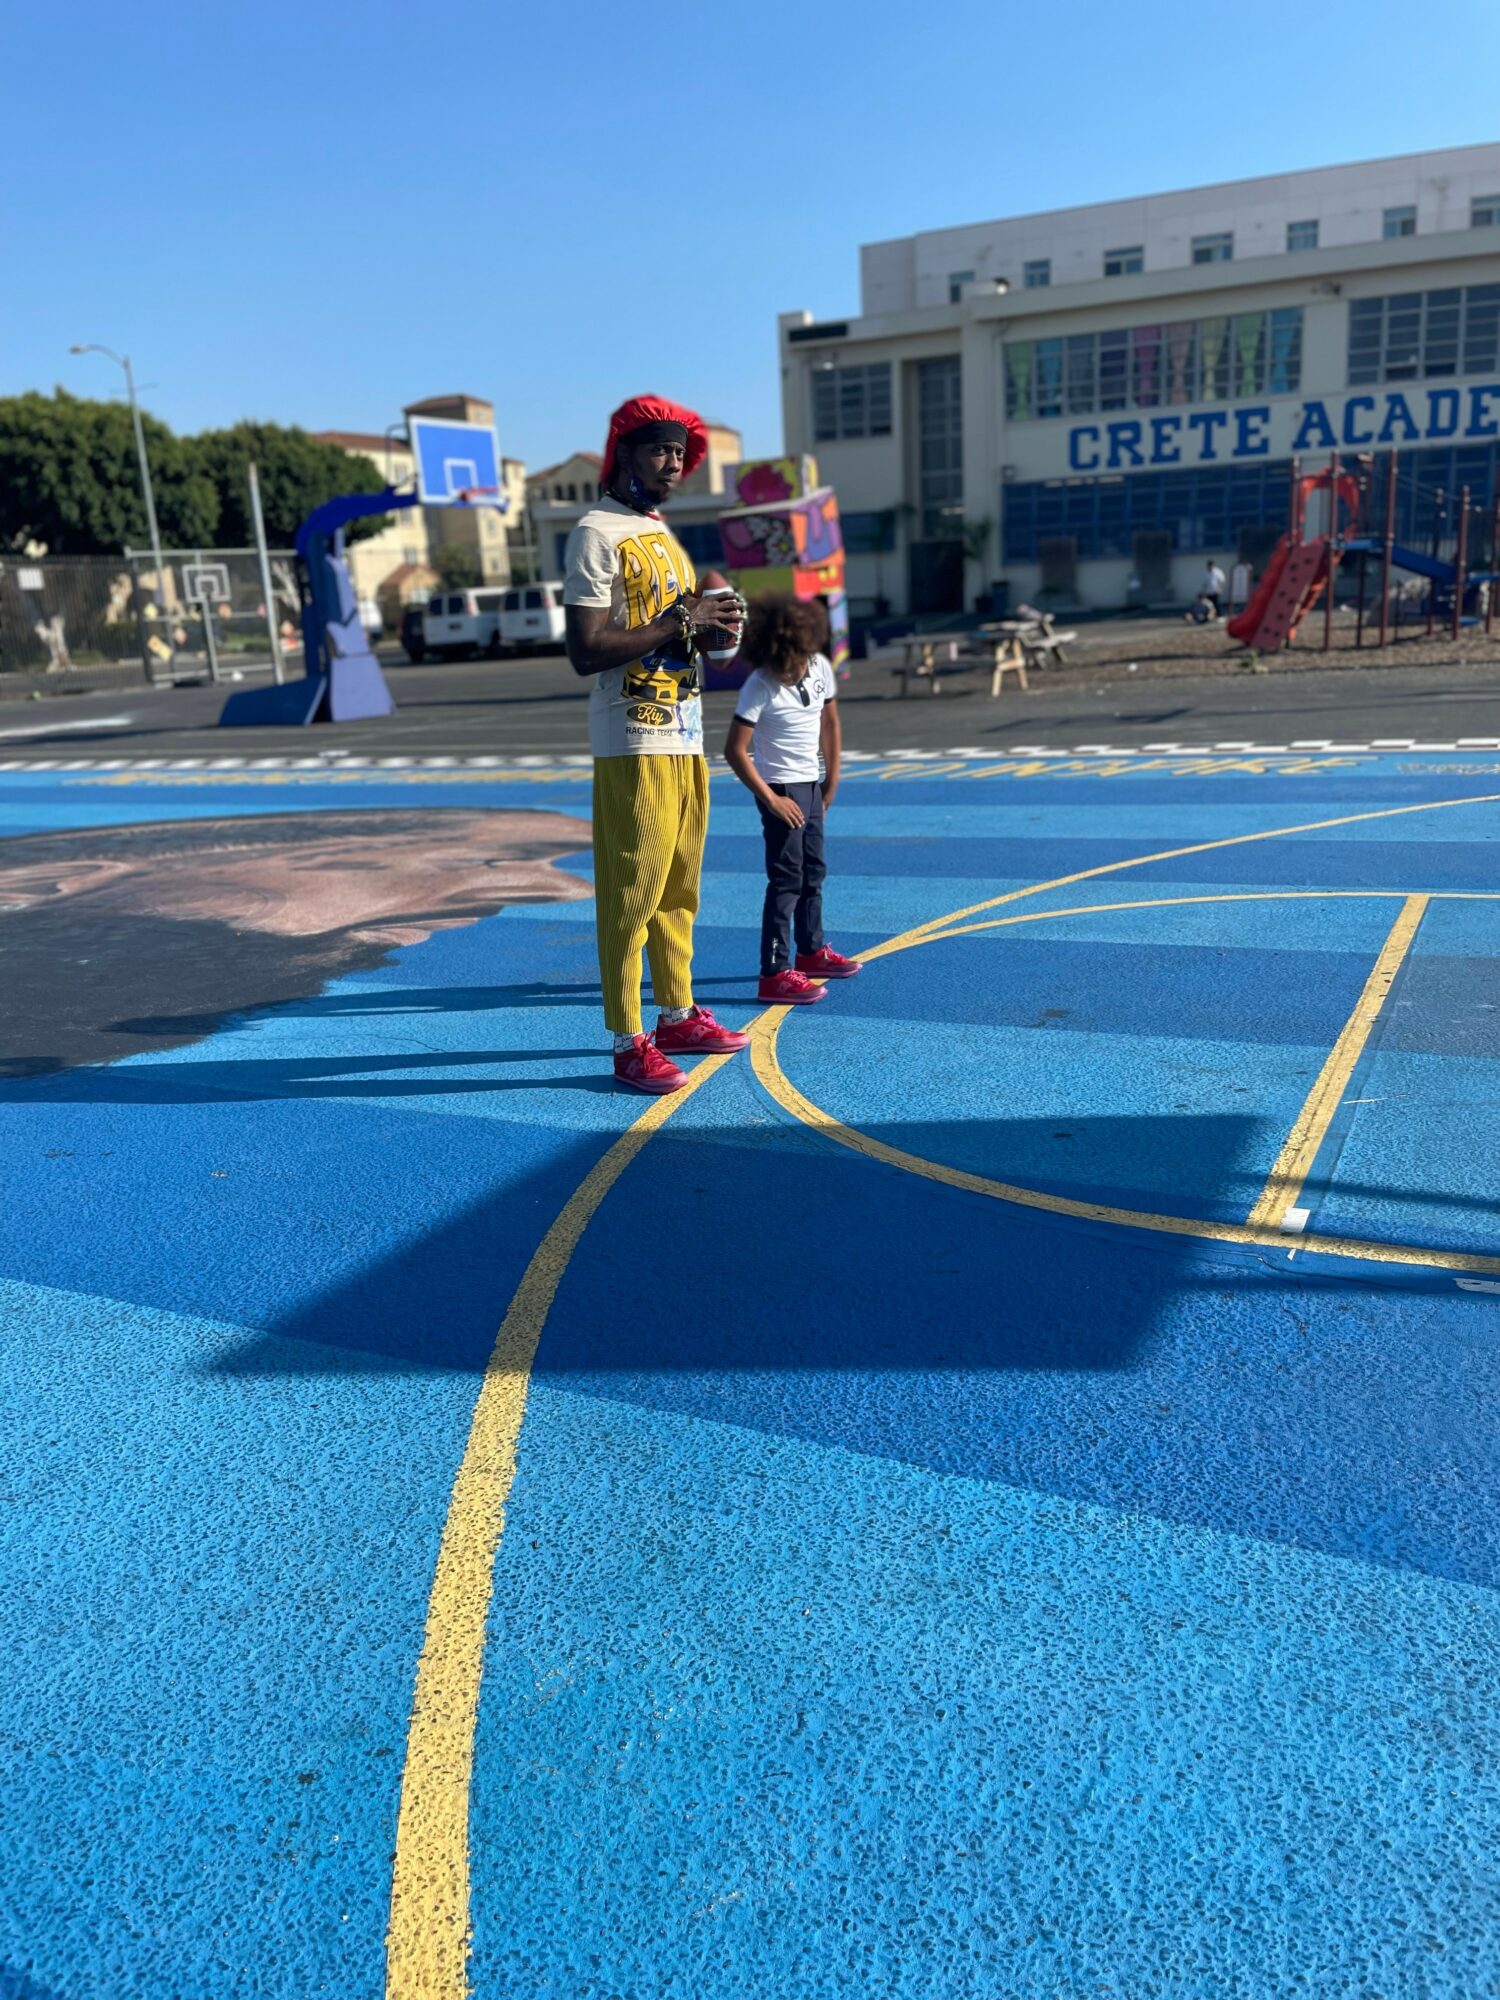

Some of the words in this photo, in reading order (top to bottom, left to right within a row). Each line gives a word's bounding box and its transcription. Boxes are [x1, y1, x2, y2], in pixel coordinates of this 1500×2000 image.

[1069, 406, 1270, 471] CRETE
[1291, 385, 1500, 450] ACADE
[625, 726, 654, 736] RACING
